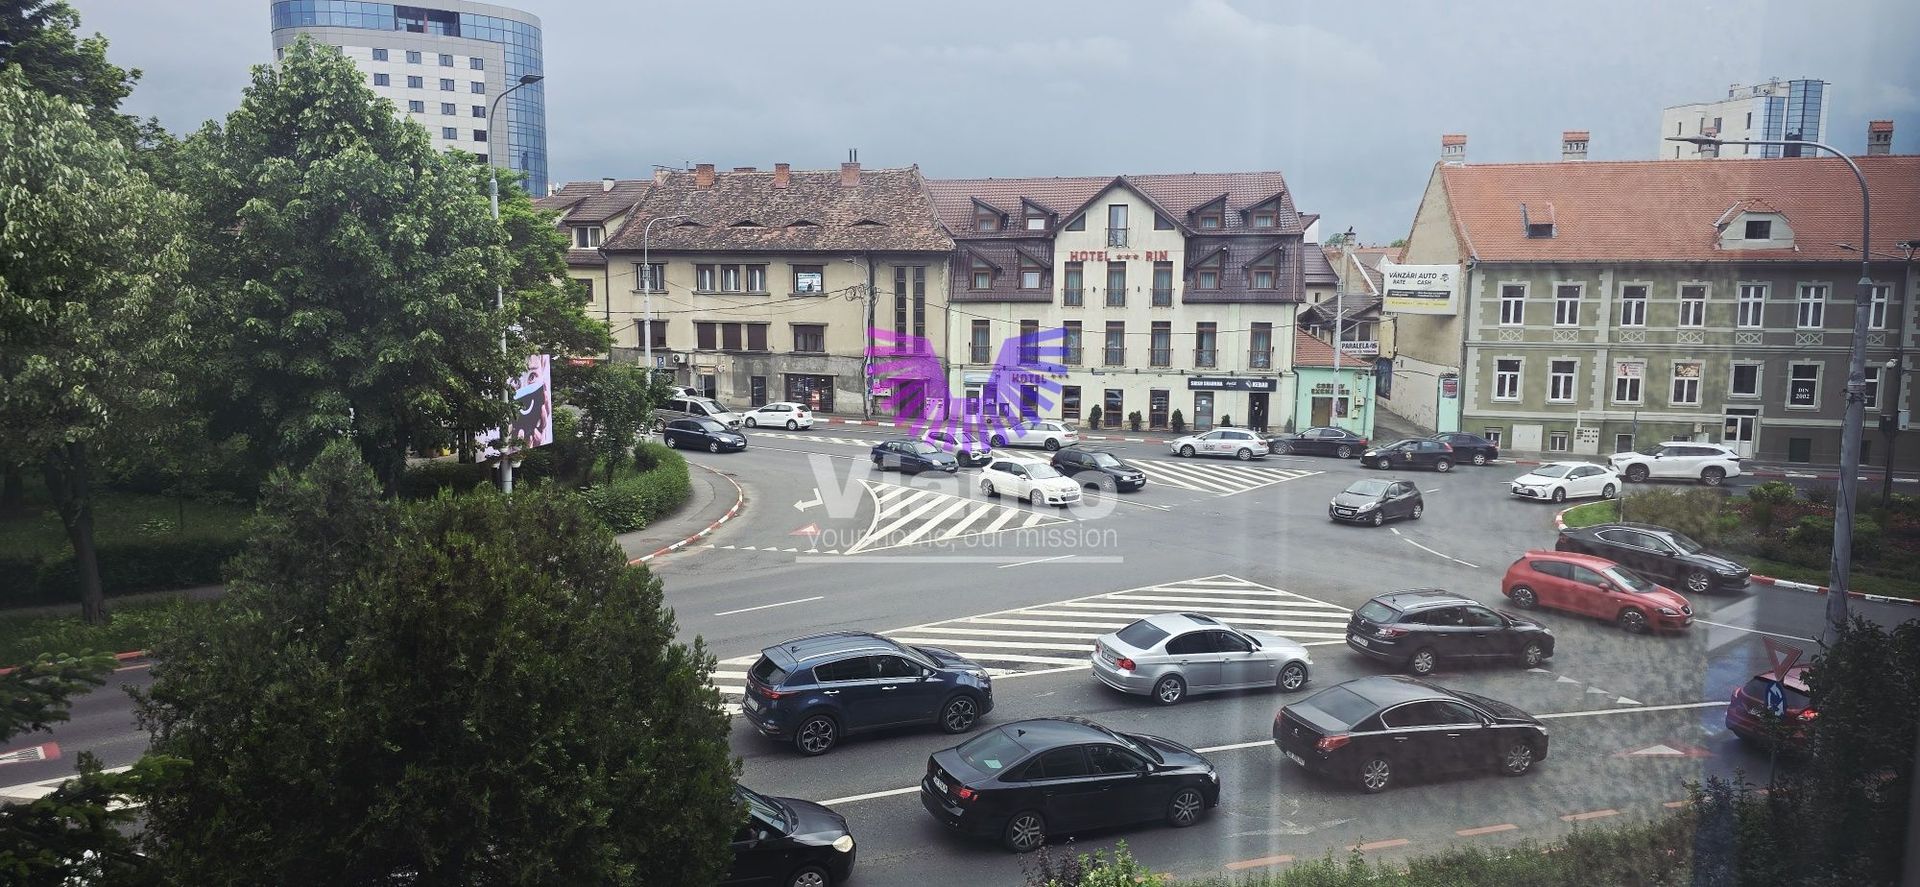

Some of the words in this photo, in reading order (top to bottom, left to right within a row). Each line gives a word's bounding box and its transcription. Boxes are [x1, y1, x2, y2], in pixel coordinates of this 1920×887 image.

[1070, 251, 1111, 262] HOTEL
[1145, 250, 1168, 262] RIN
[1012, 373, 1047, 384] HOTEL
